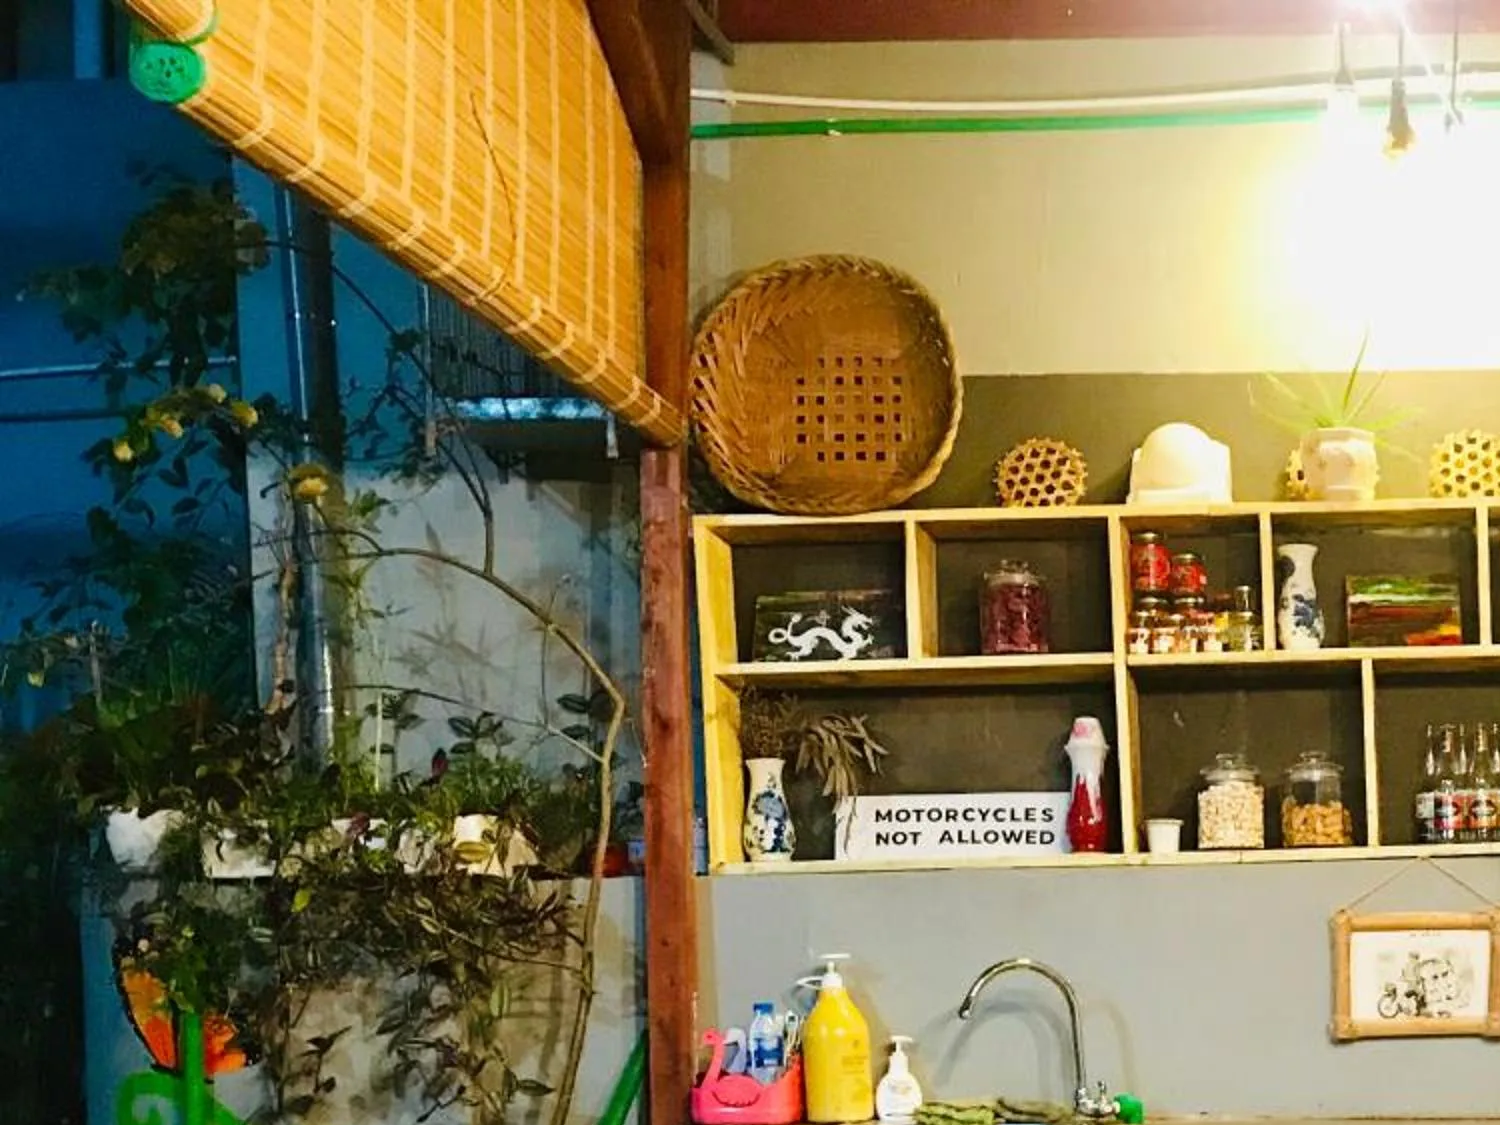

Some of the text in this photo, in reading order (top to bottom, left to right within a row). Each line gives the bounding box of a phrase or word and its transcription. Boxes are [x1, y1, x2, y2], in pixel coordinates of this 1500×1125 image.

[874, 807, 1055, 823] MOTORCYCLES
[874, 829, 1056, 847] NOT ALLOWED
